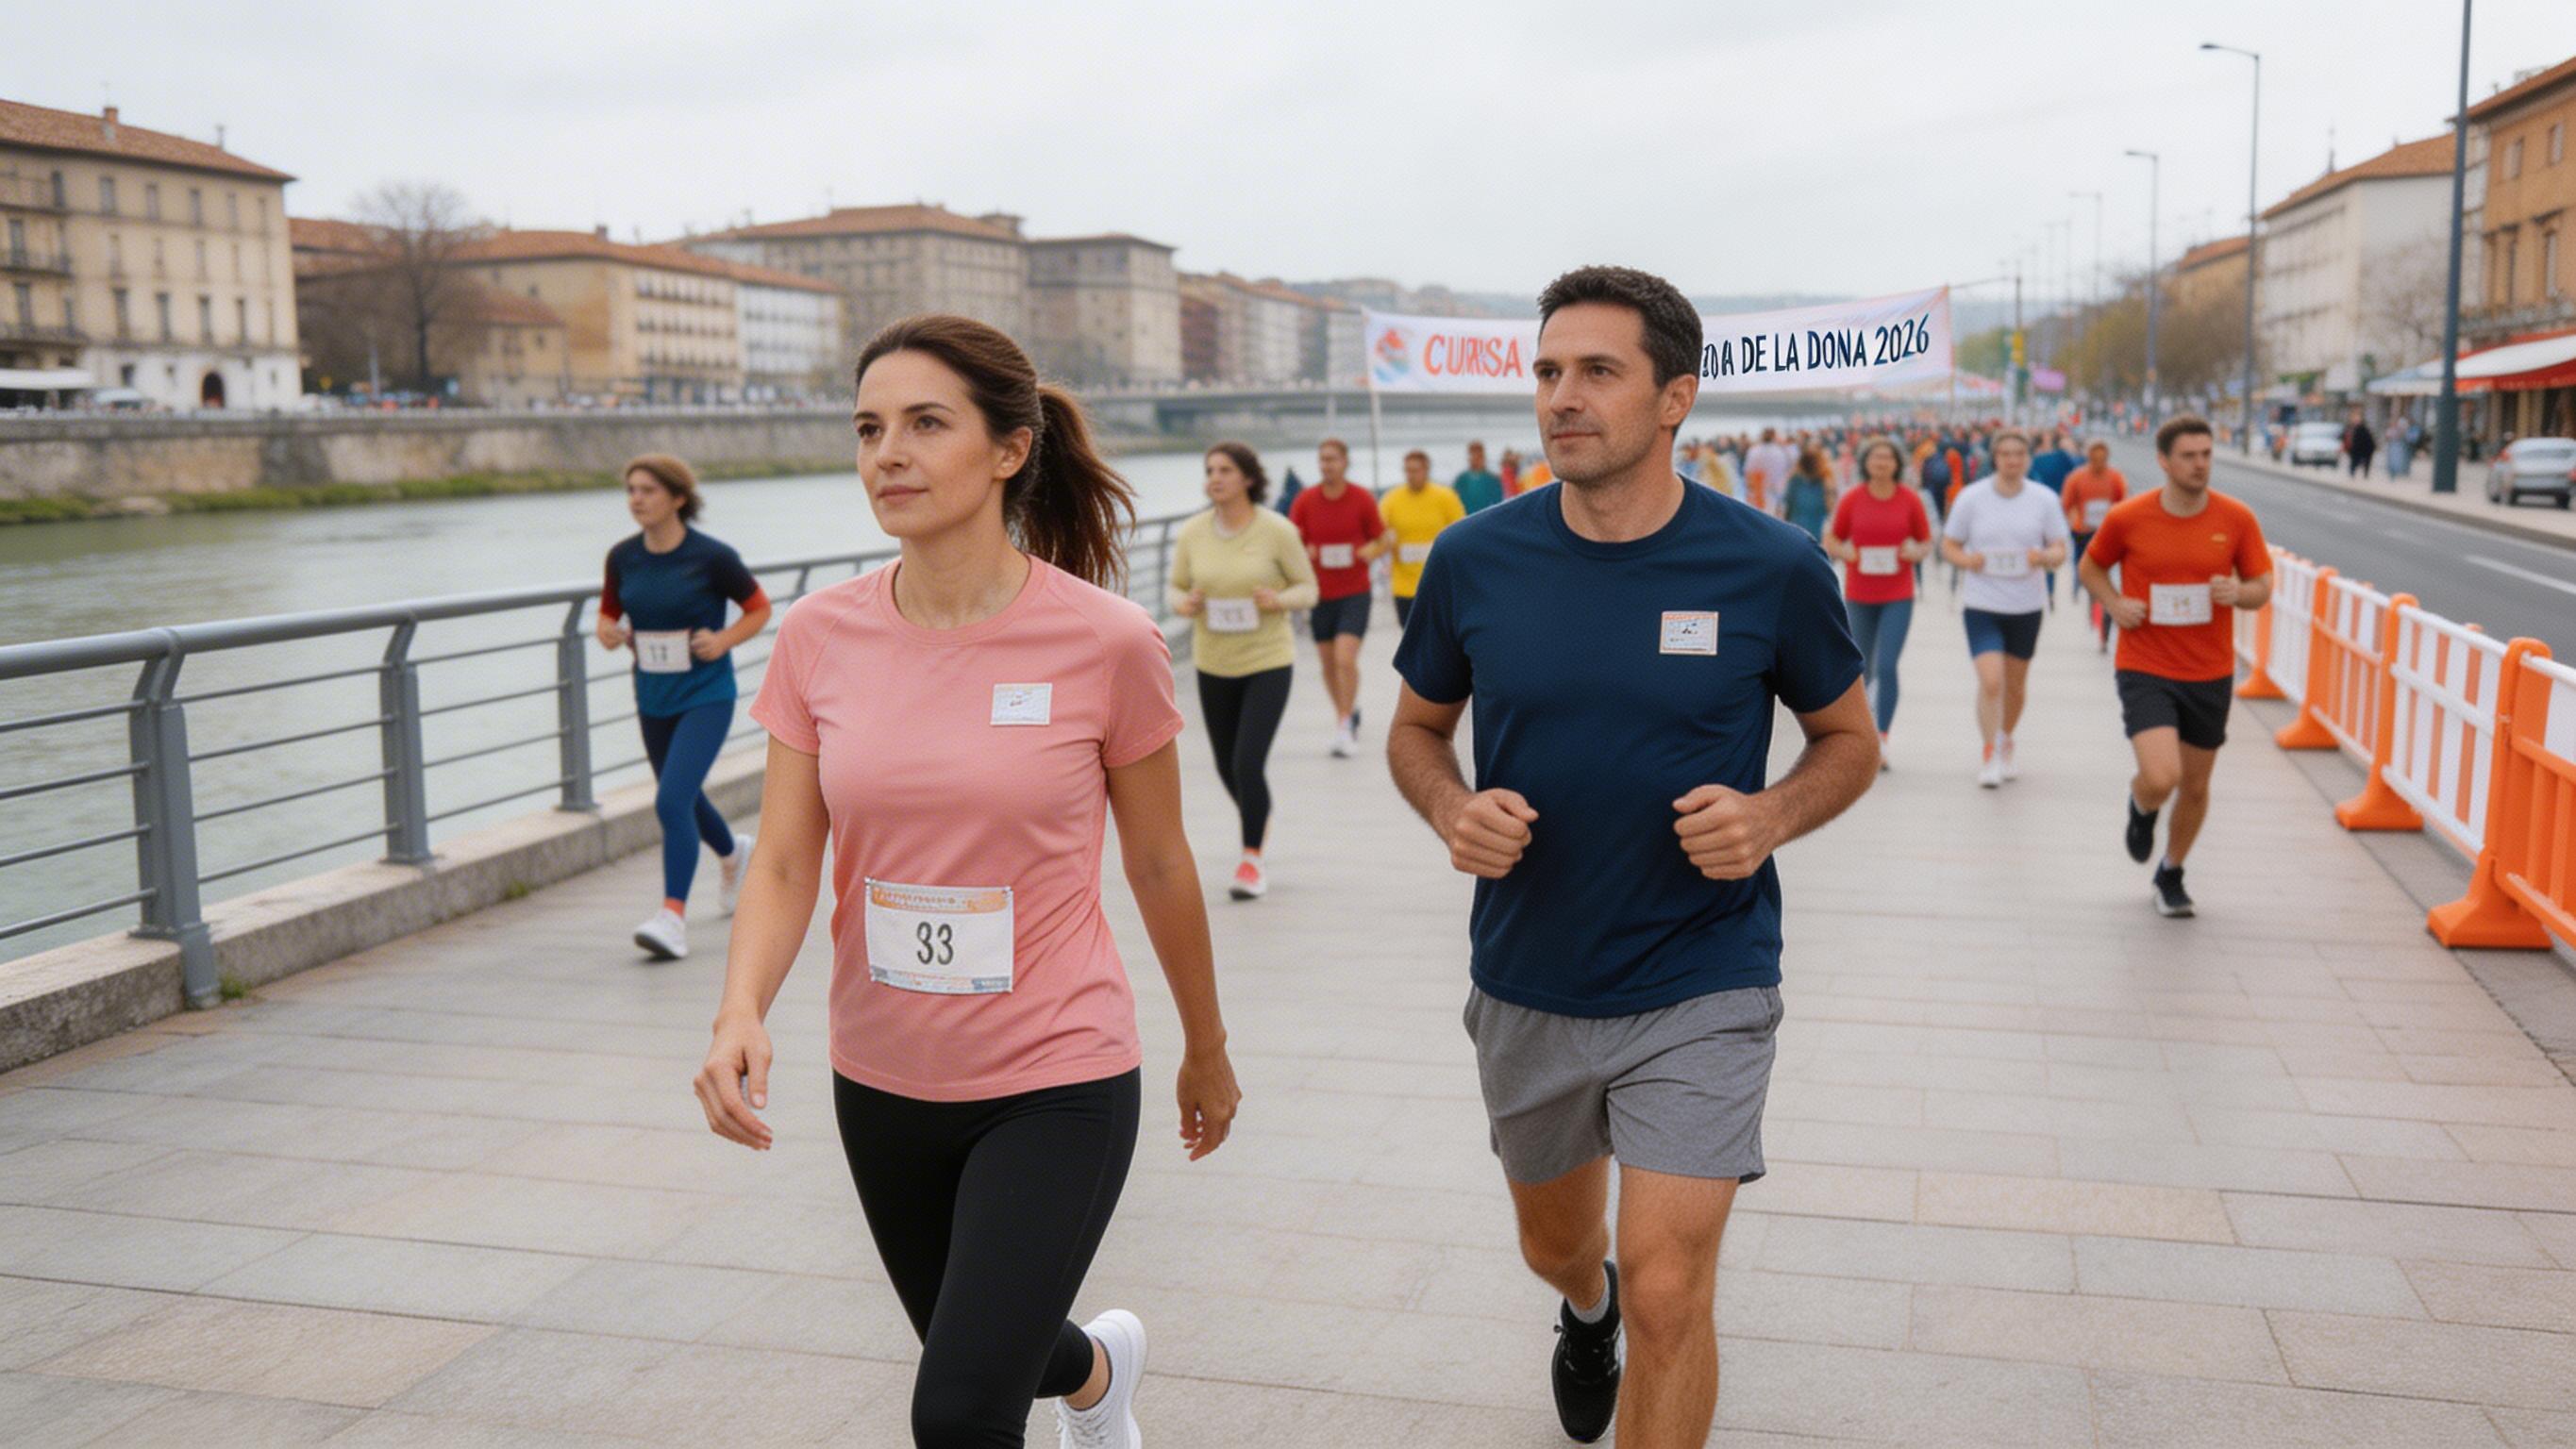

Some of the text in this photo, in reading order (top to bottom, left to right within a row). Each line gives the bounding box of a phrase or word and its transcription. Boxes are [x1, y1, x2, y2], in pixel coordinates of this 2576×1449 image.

[1741, 335, 1766, 374] DE
[1775, 332, 1799, 372] LA
[1807, 327, 1866, 370] DONA
[1873, 312, 1929, 366] 2026
